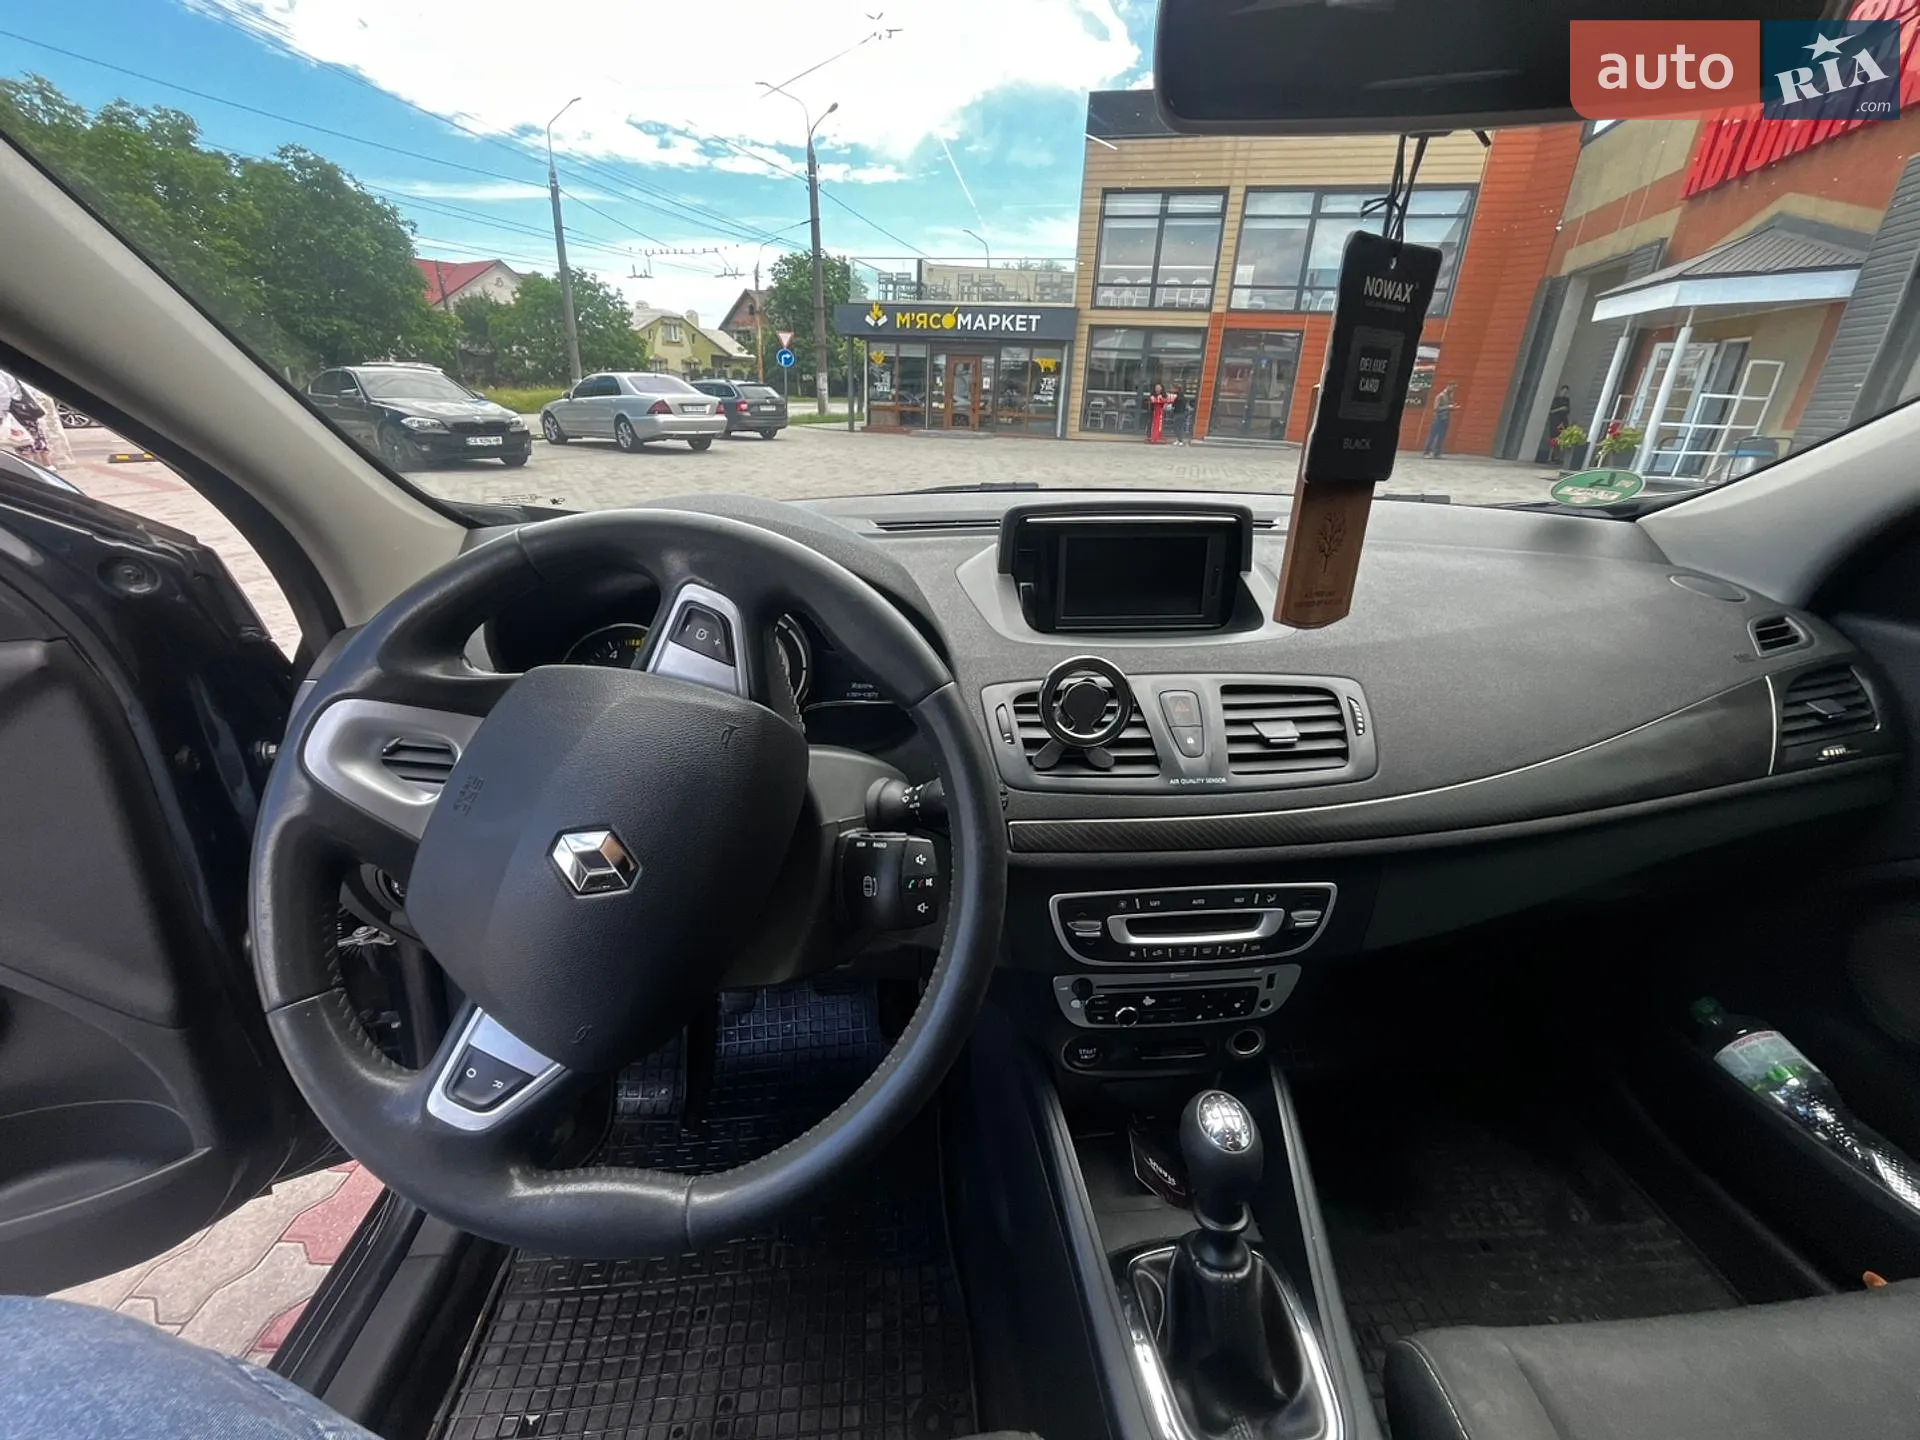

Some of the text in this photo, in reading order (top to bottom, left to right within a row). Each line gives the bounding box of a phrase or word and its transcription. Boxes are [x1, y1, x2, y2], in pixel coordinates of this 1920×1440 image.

[1363, 275, 1414, 303] NOWAX
[1360, 357, 1388, 373] DELUXE
[1359, 378, 1380, 393] CARD
[1343, 438, 1372, 450] BLACK
